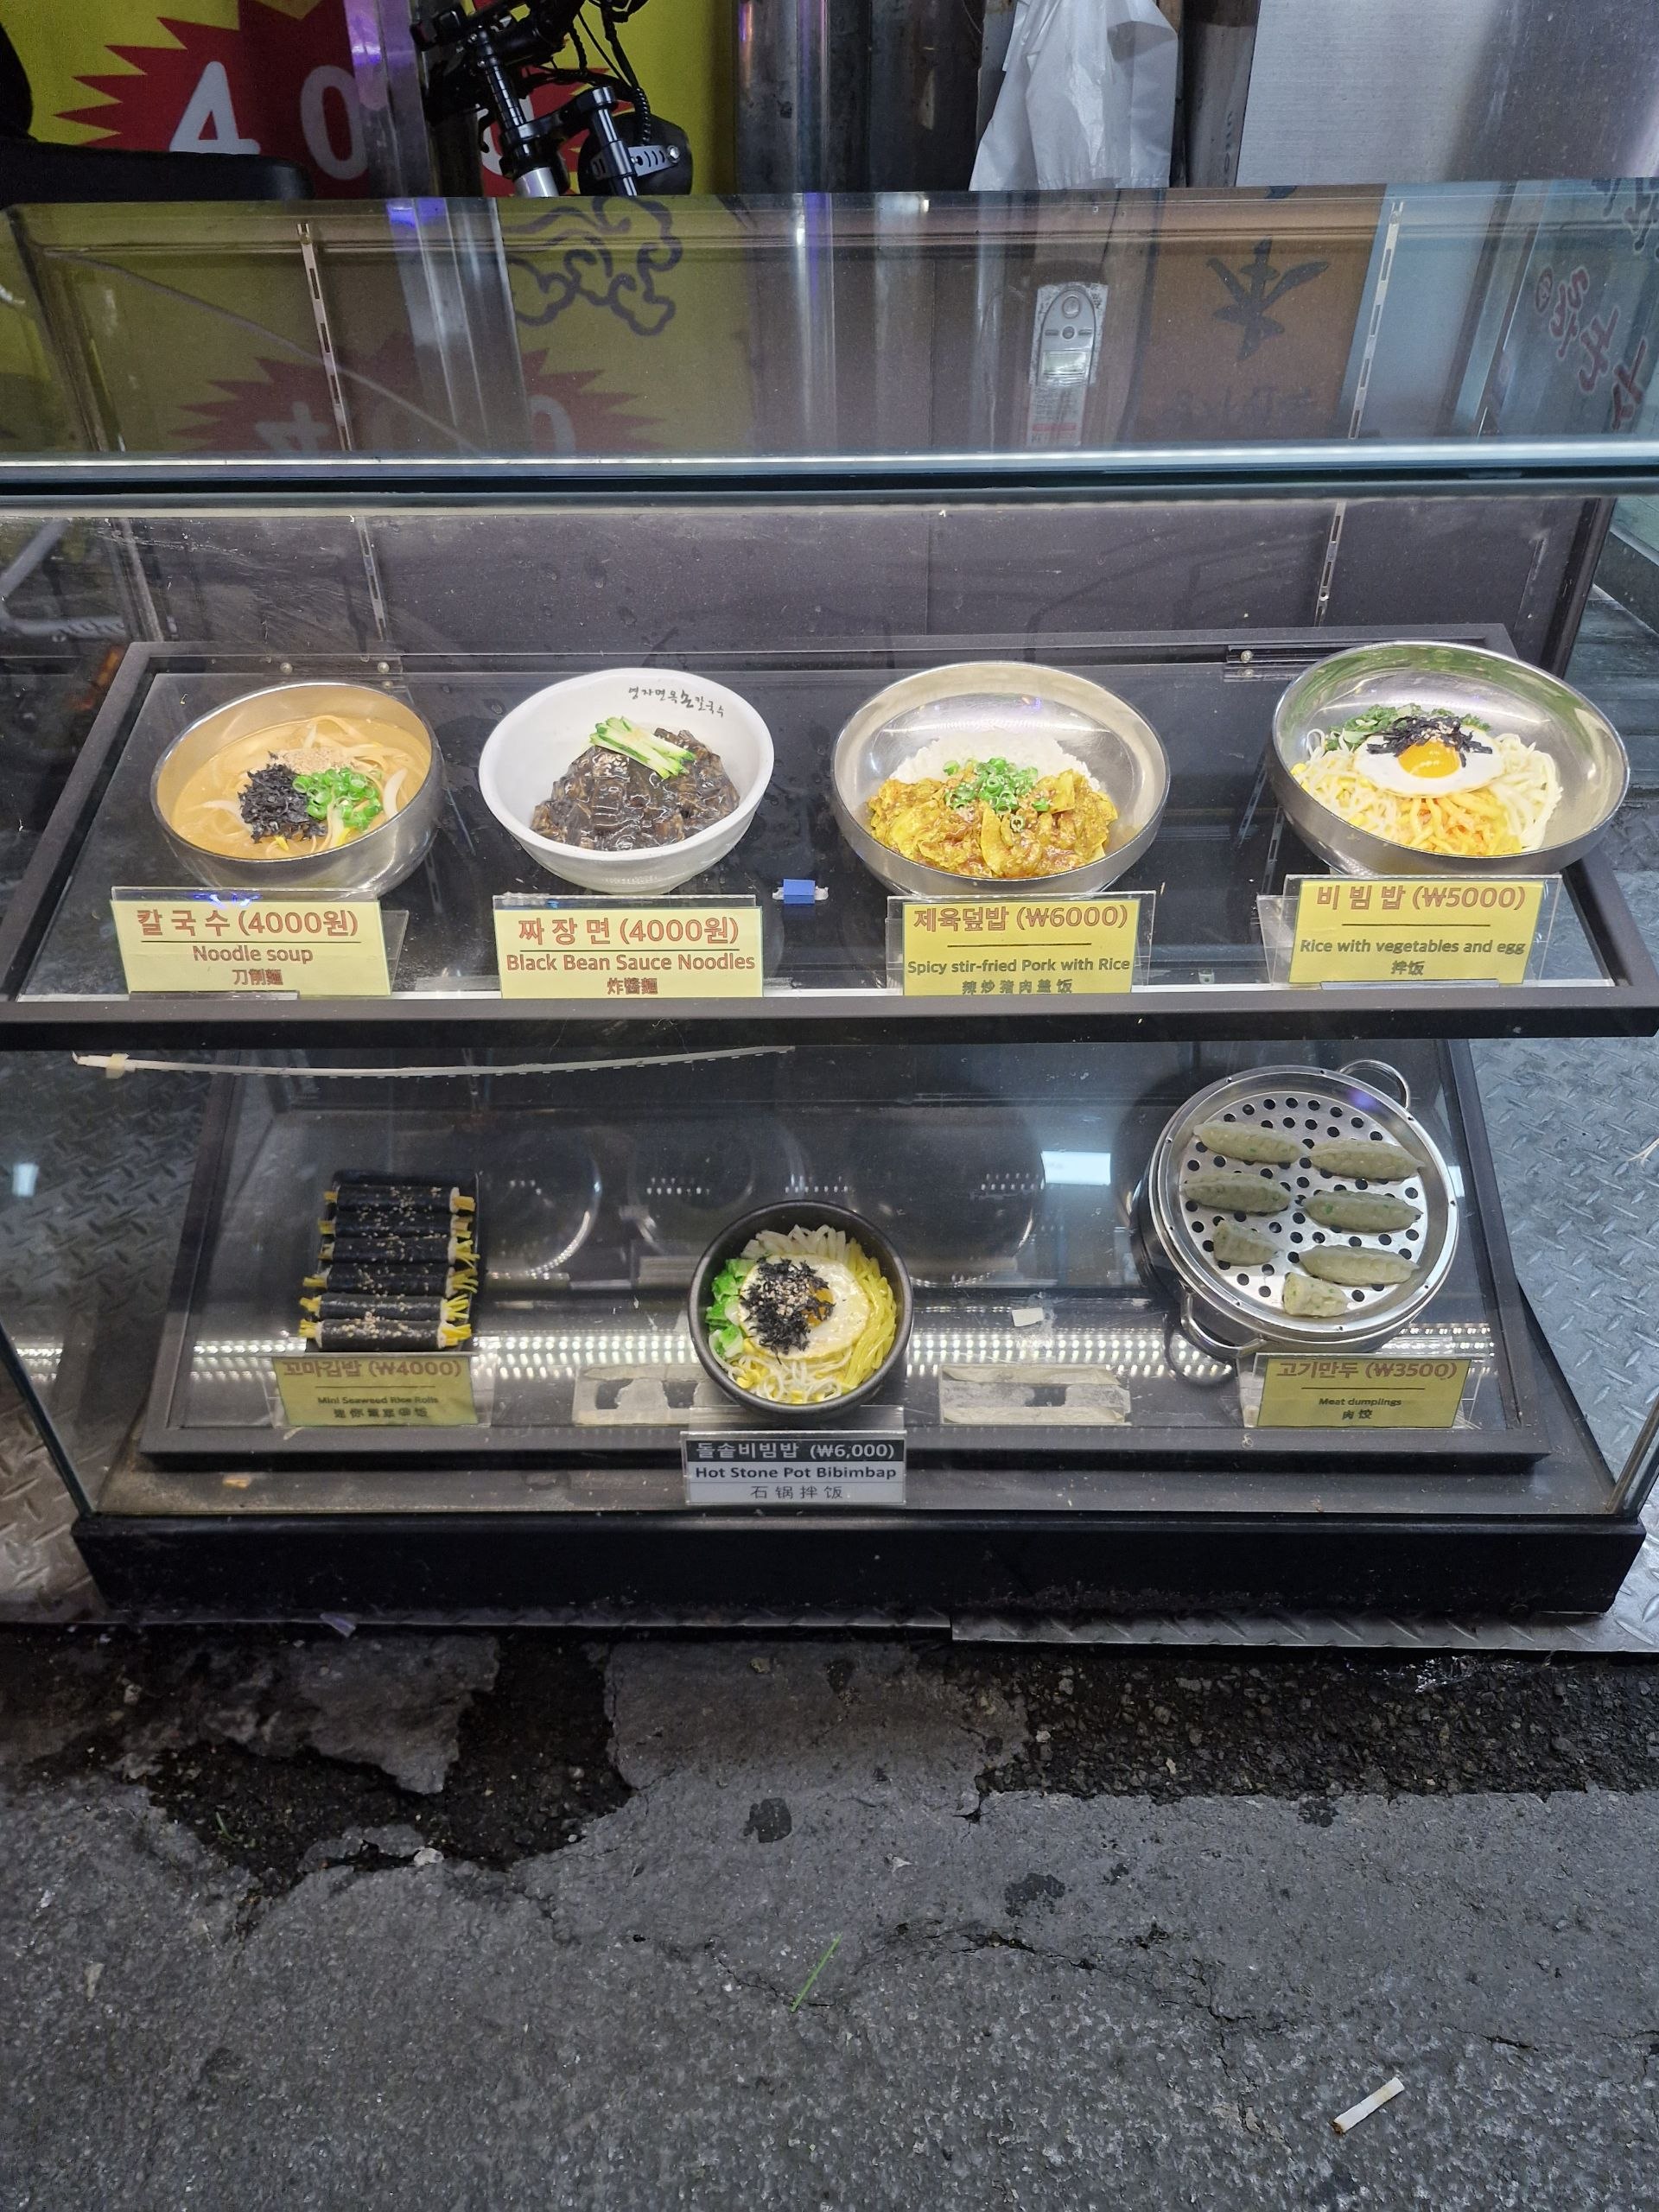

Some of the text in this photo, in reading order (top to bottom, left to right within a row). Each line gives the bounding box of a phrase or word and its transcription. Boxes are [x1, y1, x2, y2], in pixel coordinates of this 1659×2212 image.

[1316, 885, 1526, 910] 비빔밥 (₩5000)
[137, 909, 358, 937] 칼국수 (4000원)
[913, 905, 1128, 932] 제육덮밥 (₩6000)
[518, 917, 739, 945] 짜장면 (4000원)
[193, 945, 314, 963] Noodle soup
[1300, 939, 1525, 955] Rice with vegetables and egg
[506, 953, 755, 971] Black Bean Sauce Noodles
[907, 957, 1130, 976] Spicy stir-fried Pork with Rice
[1276, 1362, 1358, 1379] 고기만두
[1319, 1397, 1402, 1408] Meat dumplings
[696, 1442, 894, 1459] 돌솥비빔밥 (₩6,000)
[696, 1467, 896, 1480] Hot Stone Pot Bibimbap
[750, 1485, 843, 1499] 石锅拌饭
